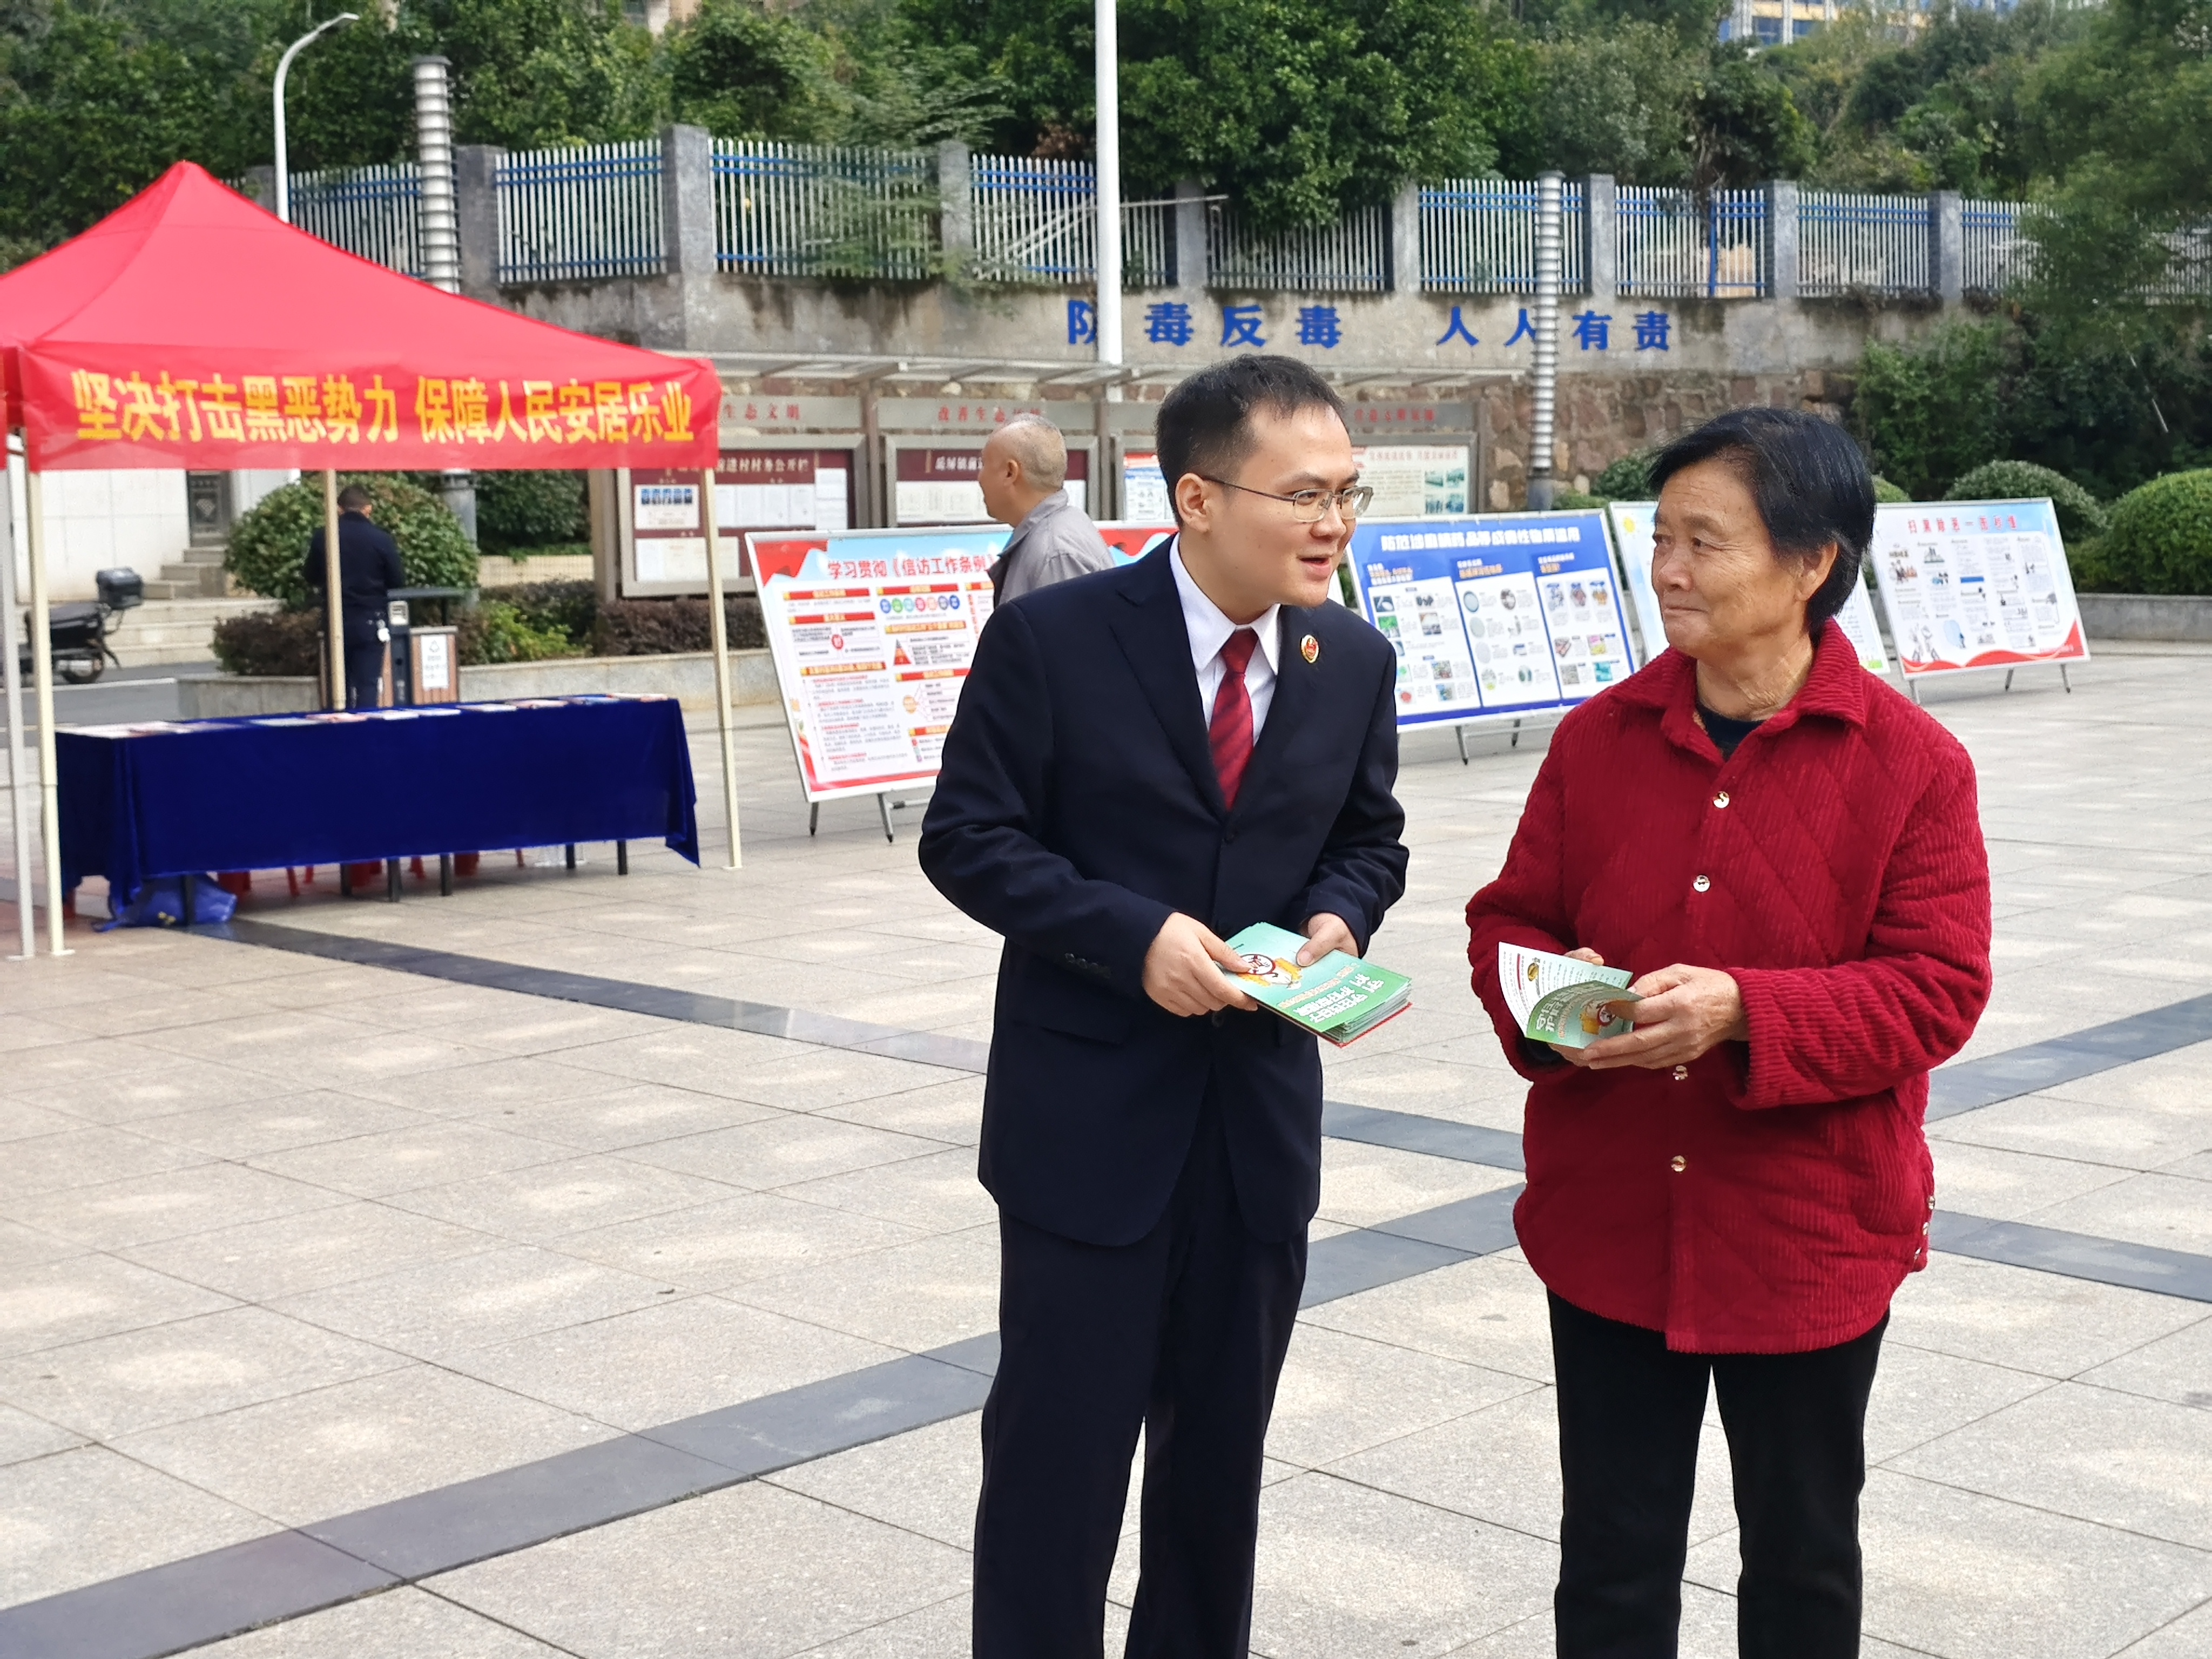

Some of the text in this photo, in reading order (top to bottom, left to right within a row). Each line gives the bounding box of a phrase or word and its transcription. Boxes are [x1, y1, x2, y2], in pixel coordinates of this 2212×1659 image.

[1437, 306, 1671, 351] 人人有责
[72, 369, 694, 445] 坚决打击黑恶势力 保障人民安居乐业
